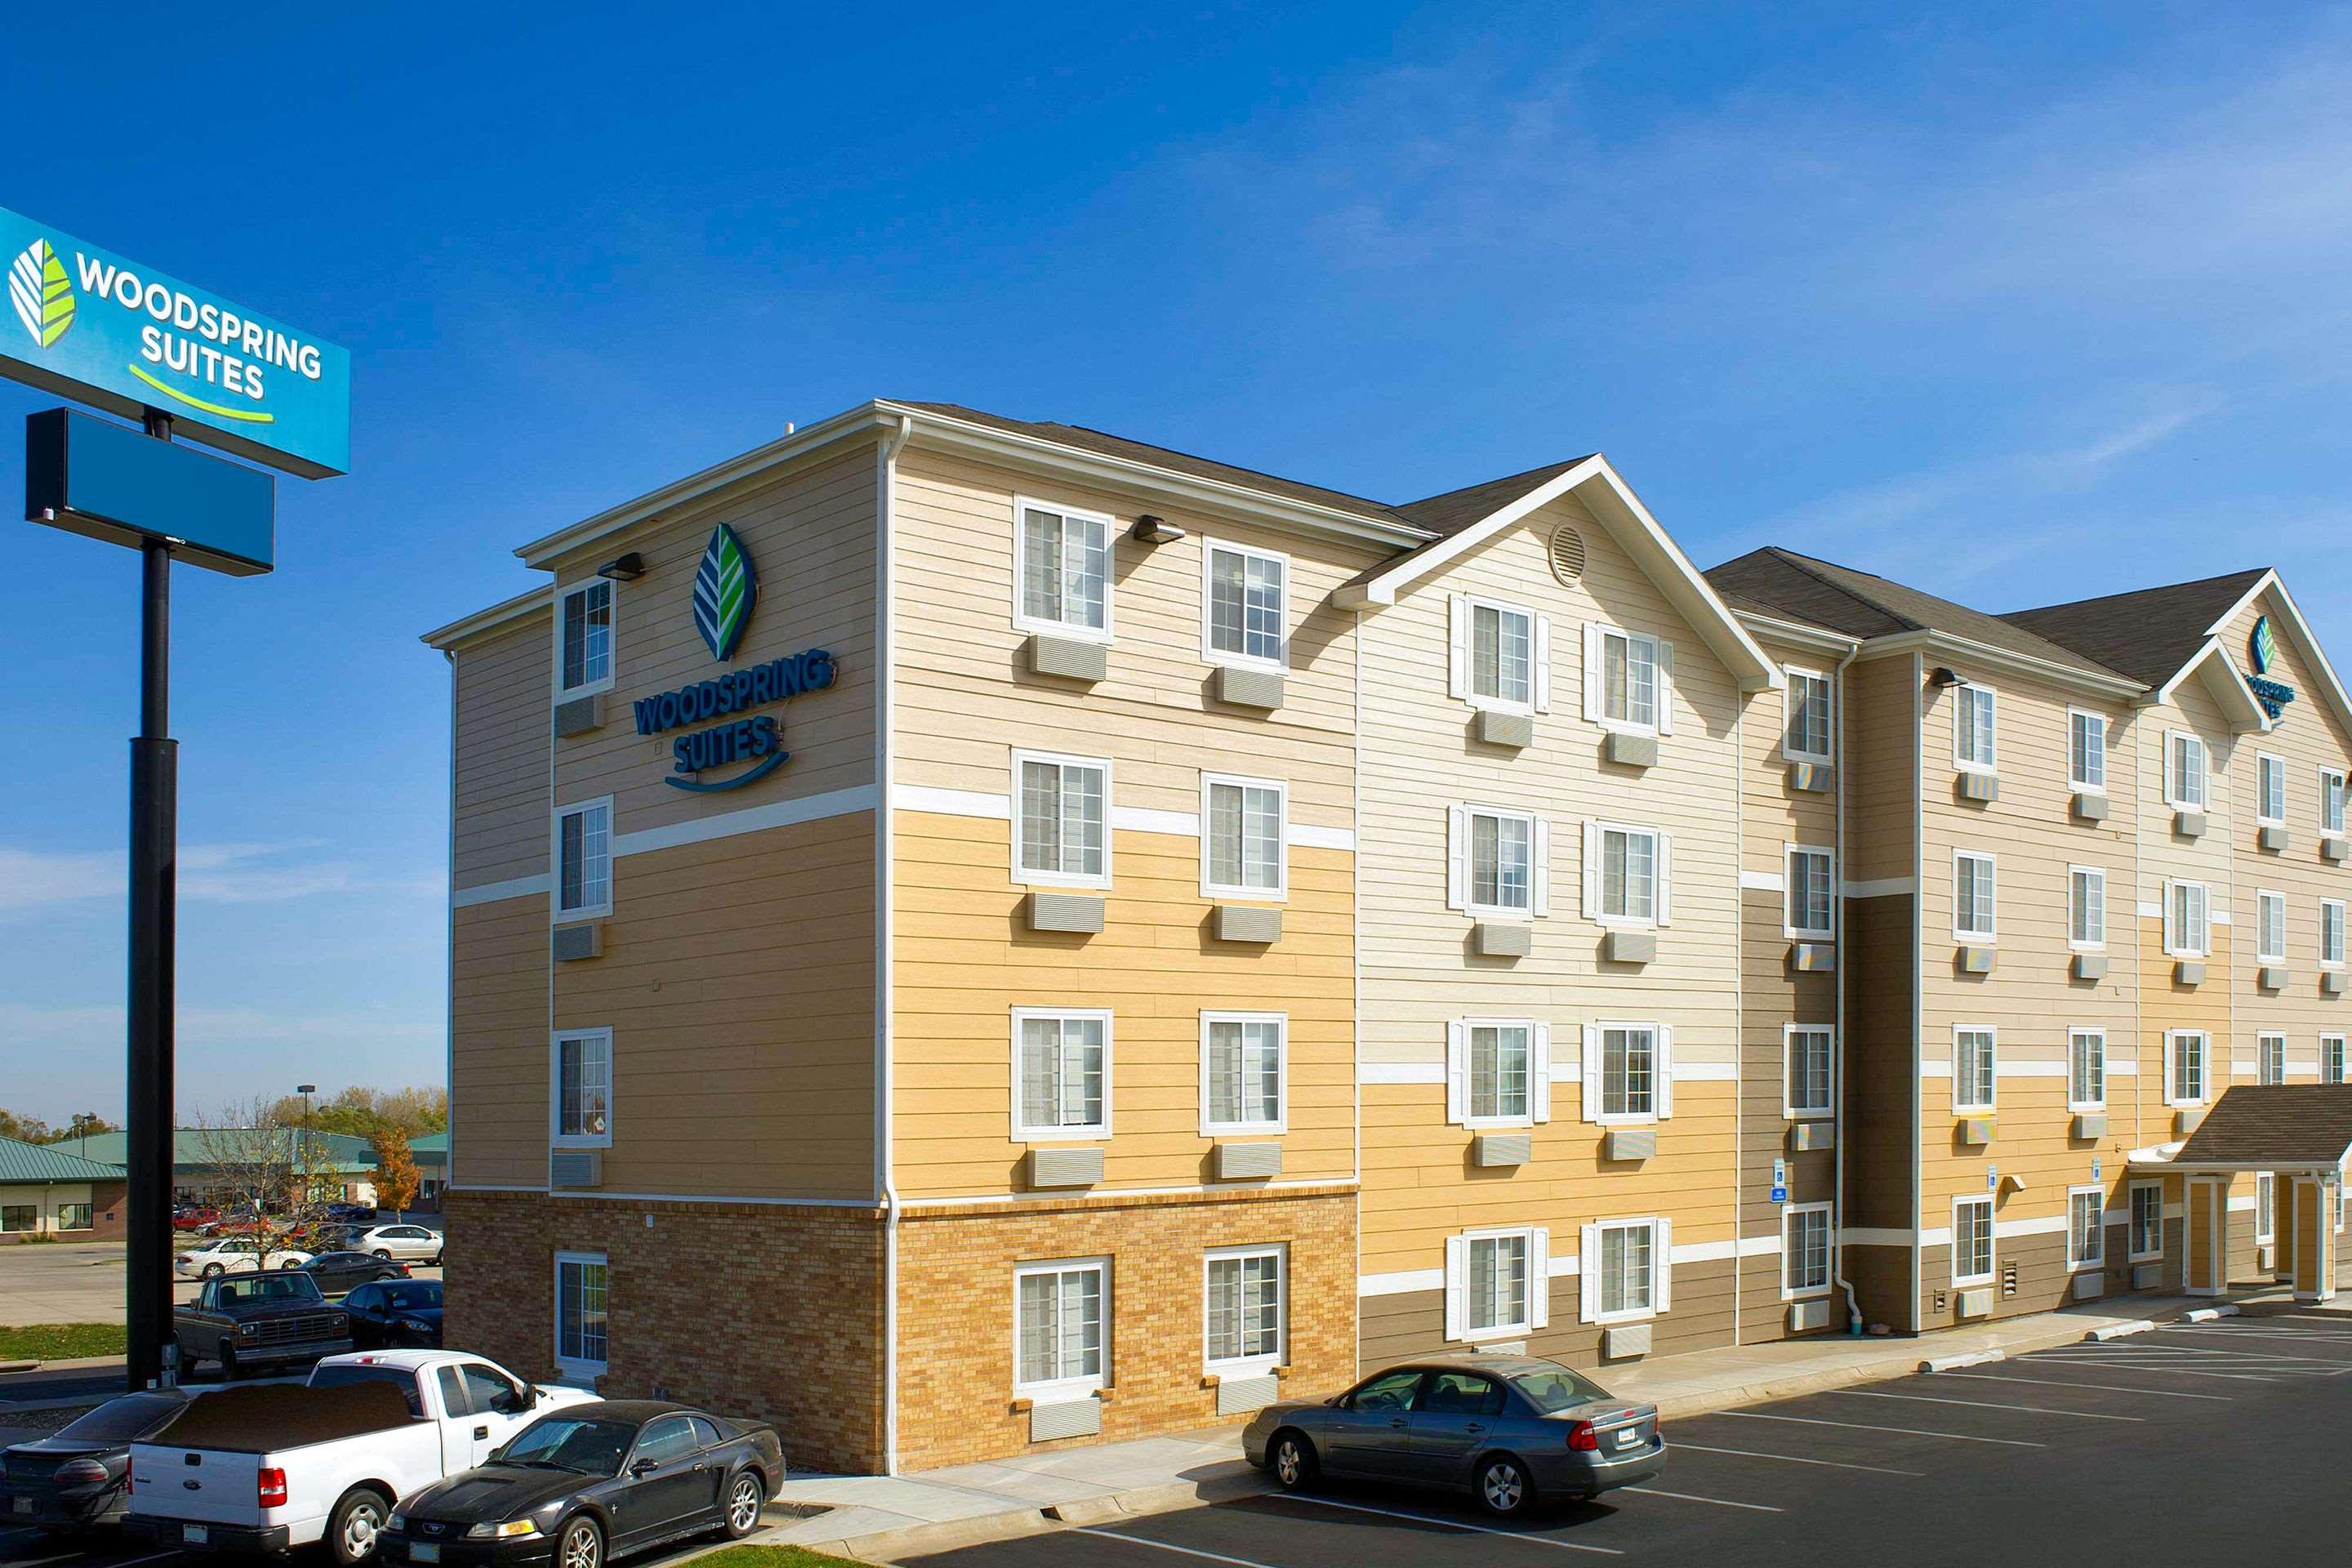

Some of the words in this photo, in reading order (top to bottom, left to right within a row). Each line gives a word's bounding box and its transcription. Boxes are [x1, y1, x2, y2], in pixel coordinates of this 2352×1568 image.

[76, 252, 322, 379] WOODSPRING
[141, 326, 265, 399] SUITES
[634, 649, 830, 734] WOODSPRING
[2244, 675, 2295, 702] ODSPRING
[674, 715, 777, 773] SUITES
